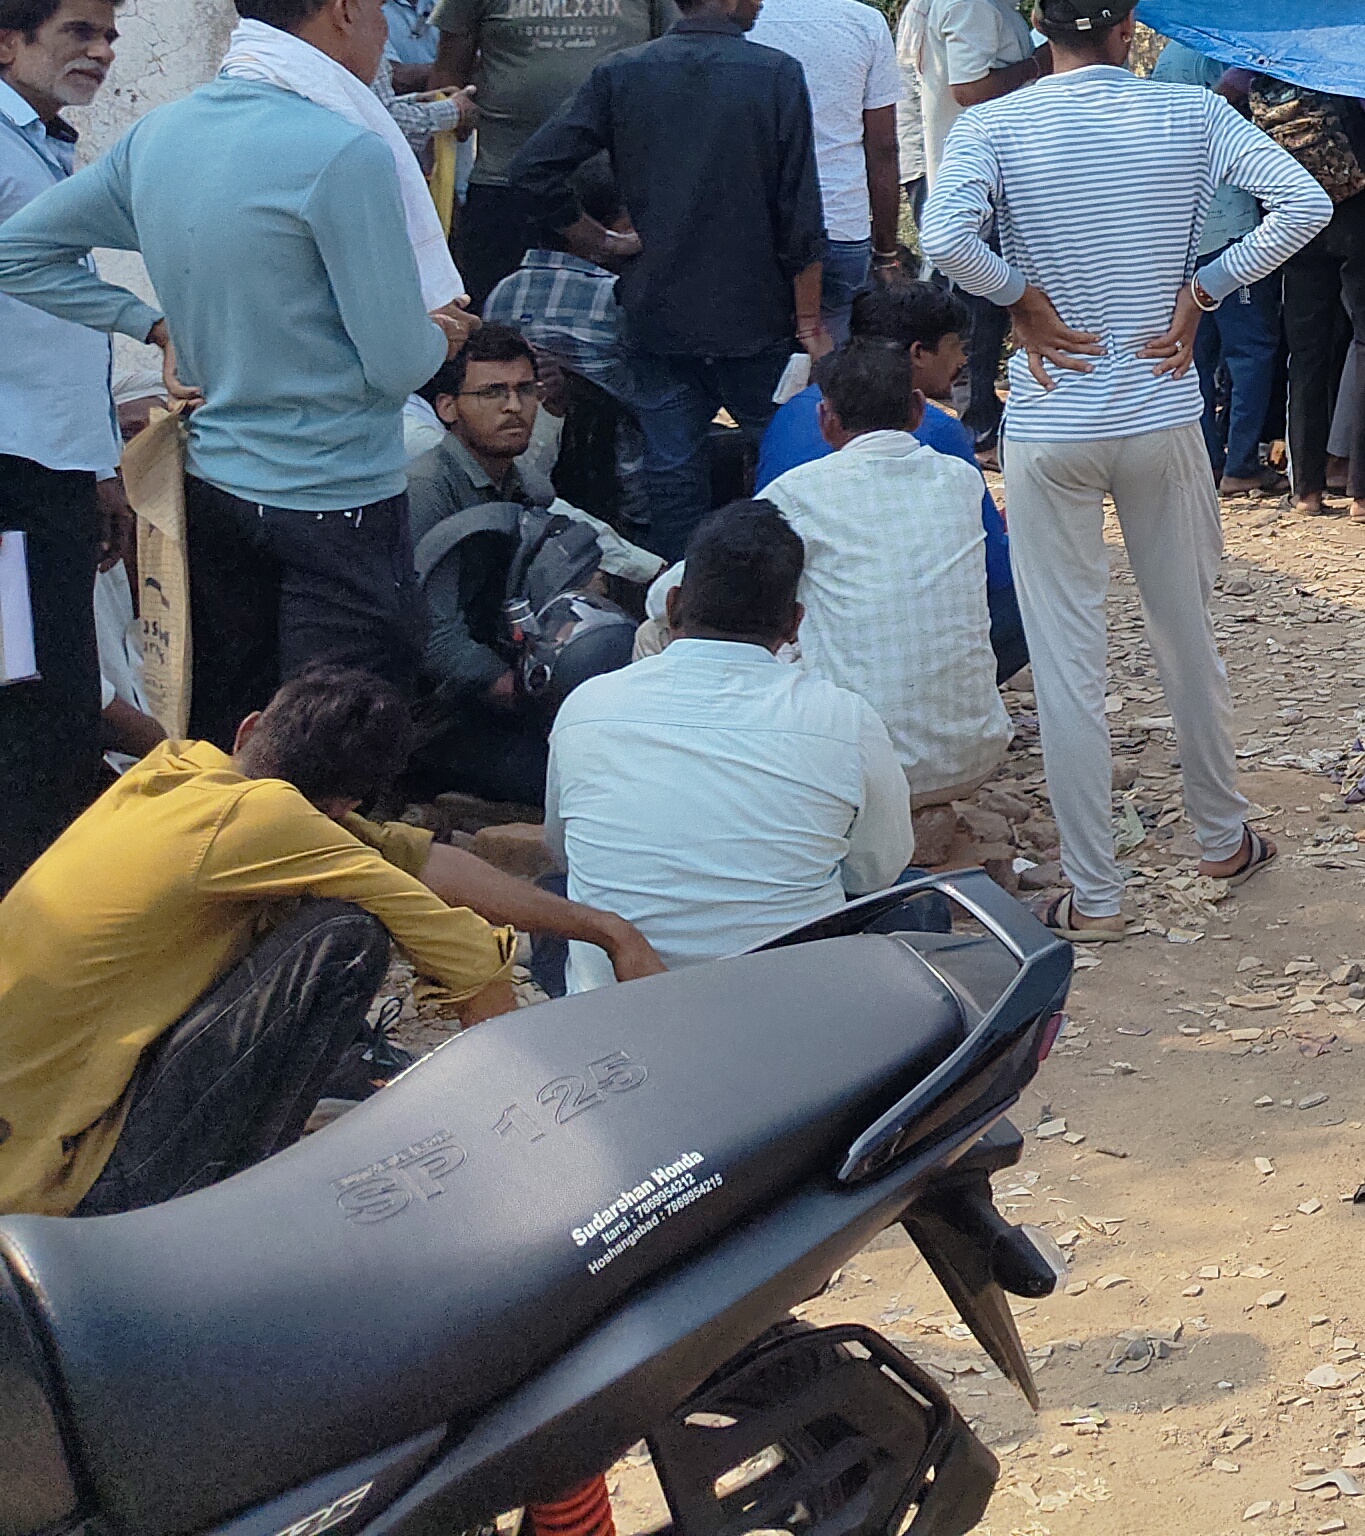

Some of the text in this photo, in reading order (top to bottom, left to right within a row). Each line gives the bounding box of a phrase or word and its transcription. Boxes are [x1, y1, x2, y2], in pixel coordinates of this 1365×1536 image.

[335, 1051, 649, 1225] SP 125
[572, 1148, 706, 1248] Sudarshan Honda
[588, 1213, 661, 1276] Hoshangabad
